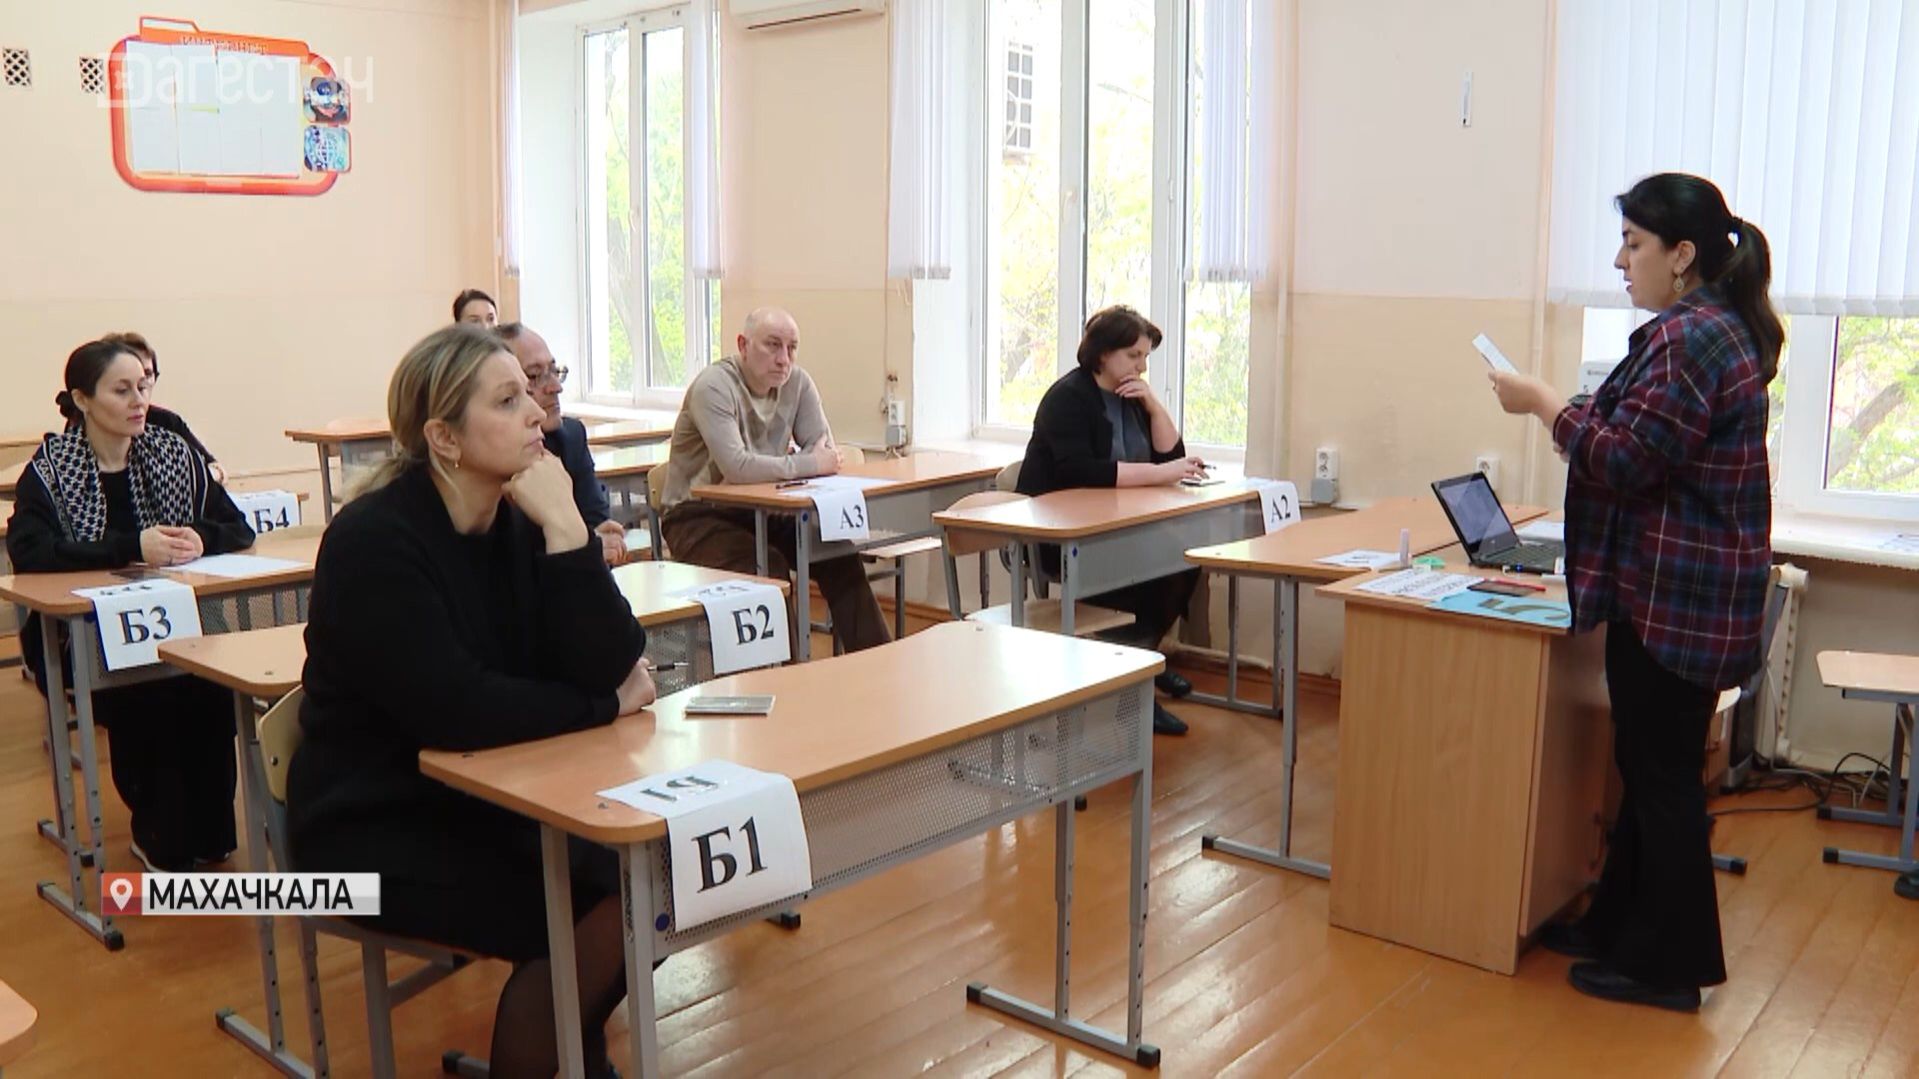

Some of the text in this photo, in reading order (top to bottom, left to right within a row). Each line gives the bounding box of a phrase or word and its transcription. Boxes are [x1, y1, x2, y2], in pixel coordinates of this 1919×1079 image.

[253, 506, 290, 533] Б4
[839, 504, 865, 530] А3
[1270, 494, 1291, 523] А2
[116, 605, 172, 646] Б3
[731, 604, 775, 646] Б2
[690, 816, 768, 894] Б1
